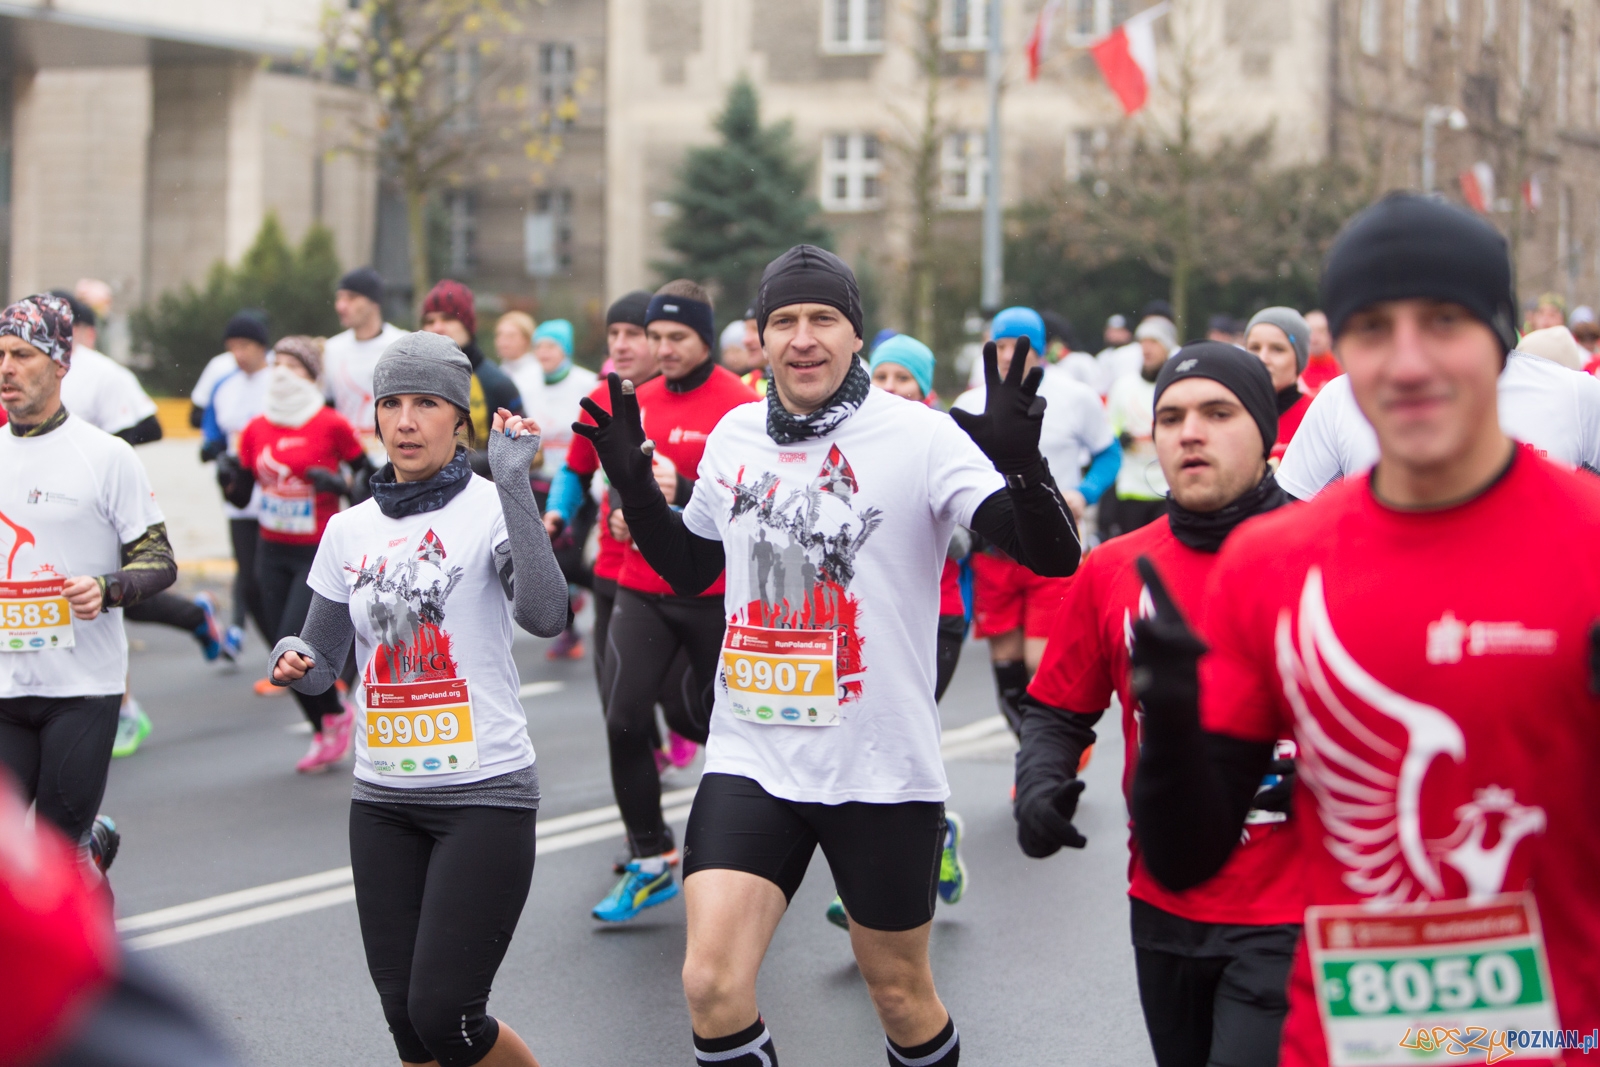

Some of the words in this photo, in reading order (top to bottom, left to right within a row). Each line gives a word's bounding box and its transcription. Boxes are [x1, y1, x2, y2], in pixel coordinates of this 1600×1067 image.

[775, 640, 827, 650] RunPoland.org
[402, 653, 447, 673] BIEG
[735, 658, 821, 692] 9907
[411, 690, 461, 701] RunPoland.org
[368, 724, 375, 735] D
[376, 711, 460, 744] 9909
[1347, 952, 1522, 1014] 8050
